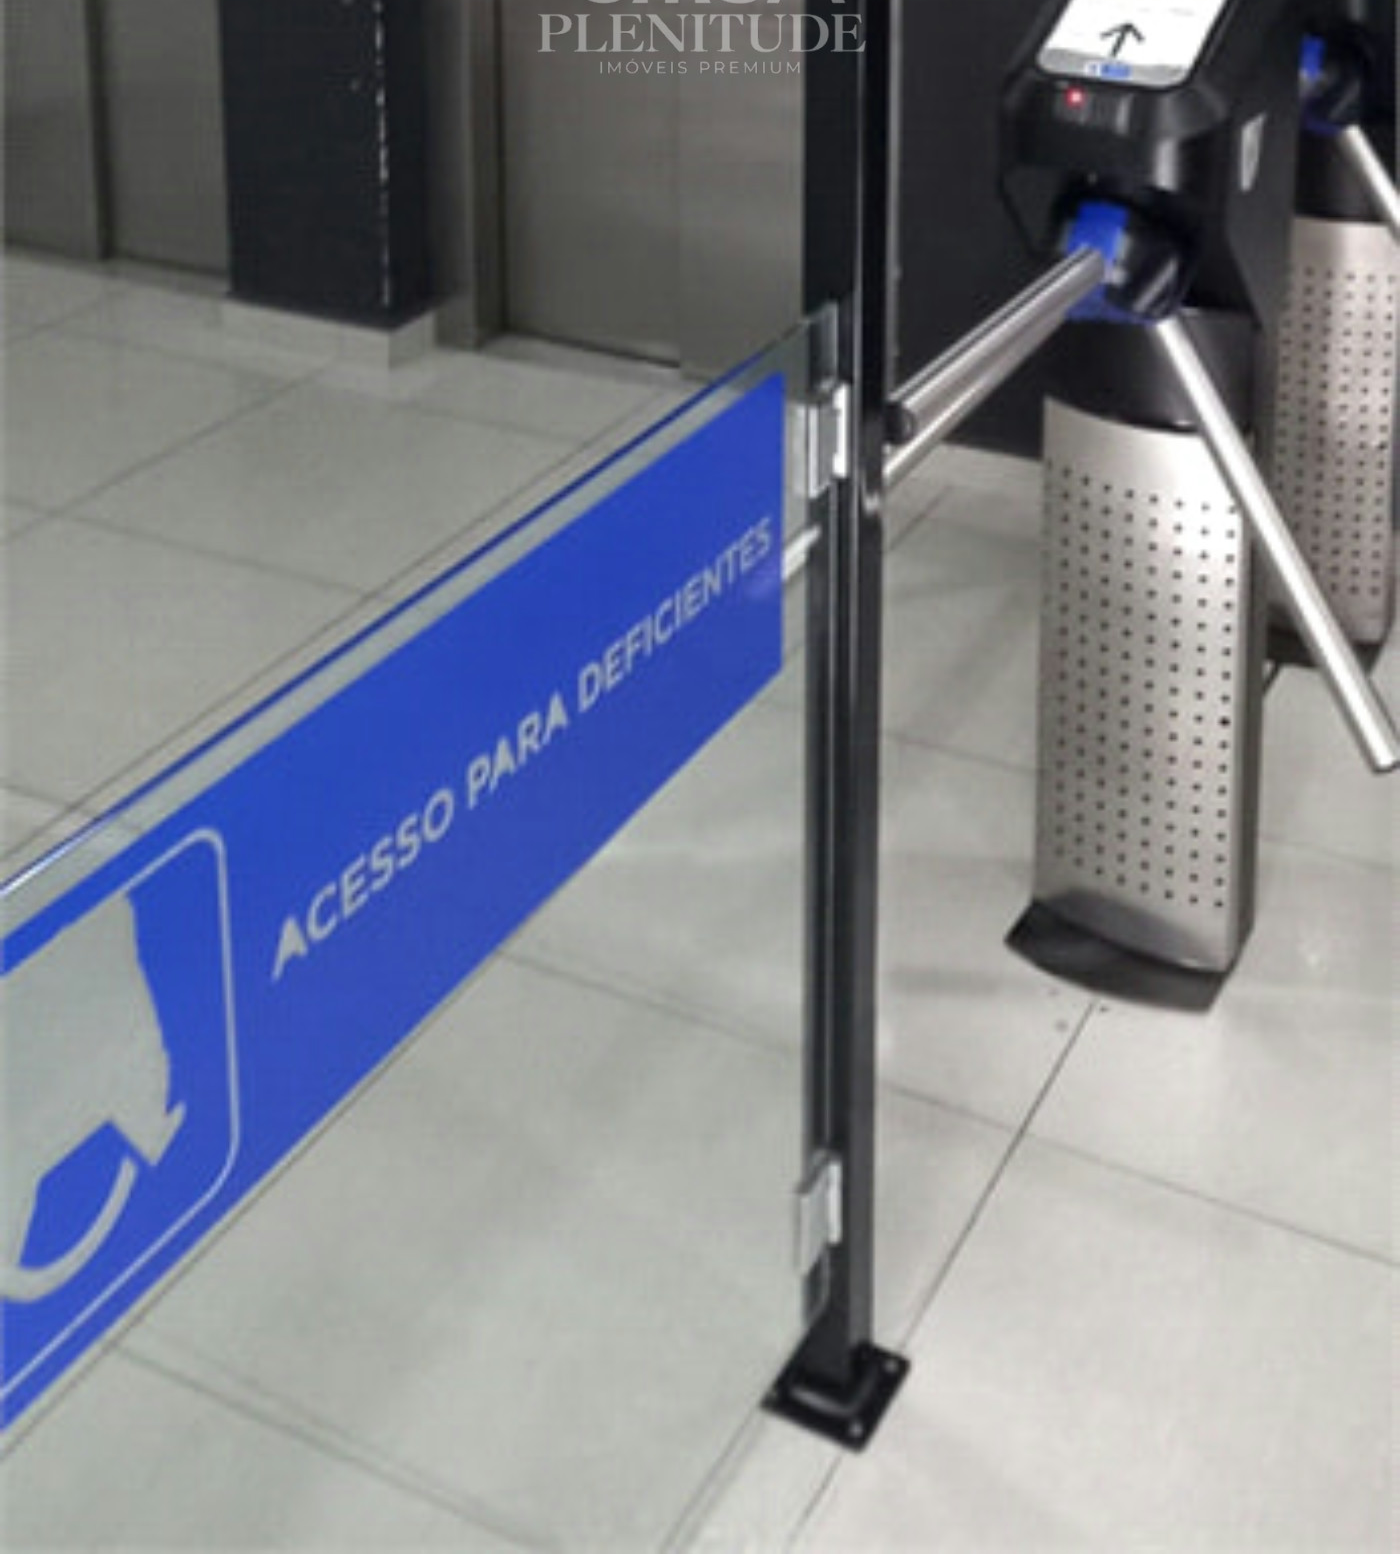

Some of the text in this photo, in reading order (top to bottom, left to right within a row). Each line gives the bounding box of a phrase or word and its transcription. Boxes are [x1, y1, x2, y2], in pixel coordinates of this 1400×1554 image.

[273, 517, 772, 981] ACESSO PARA DEFICIENTES
